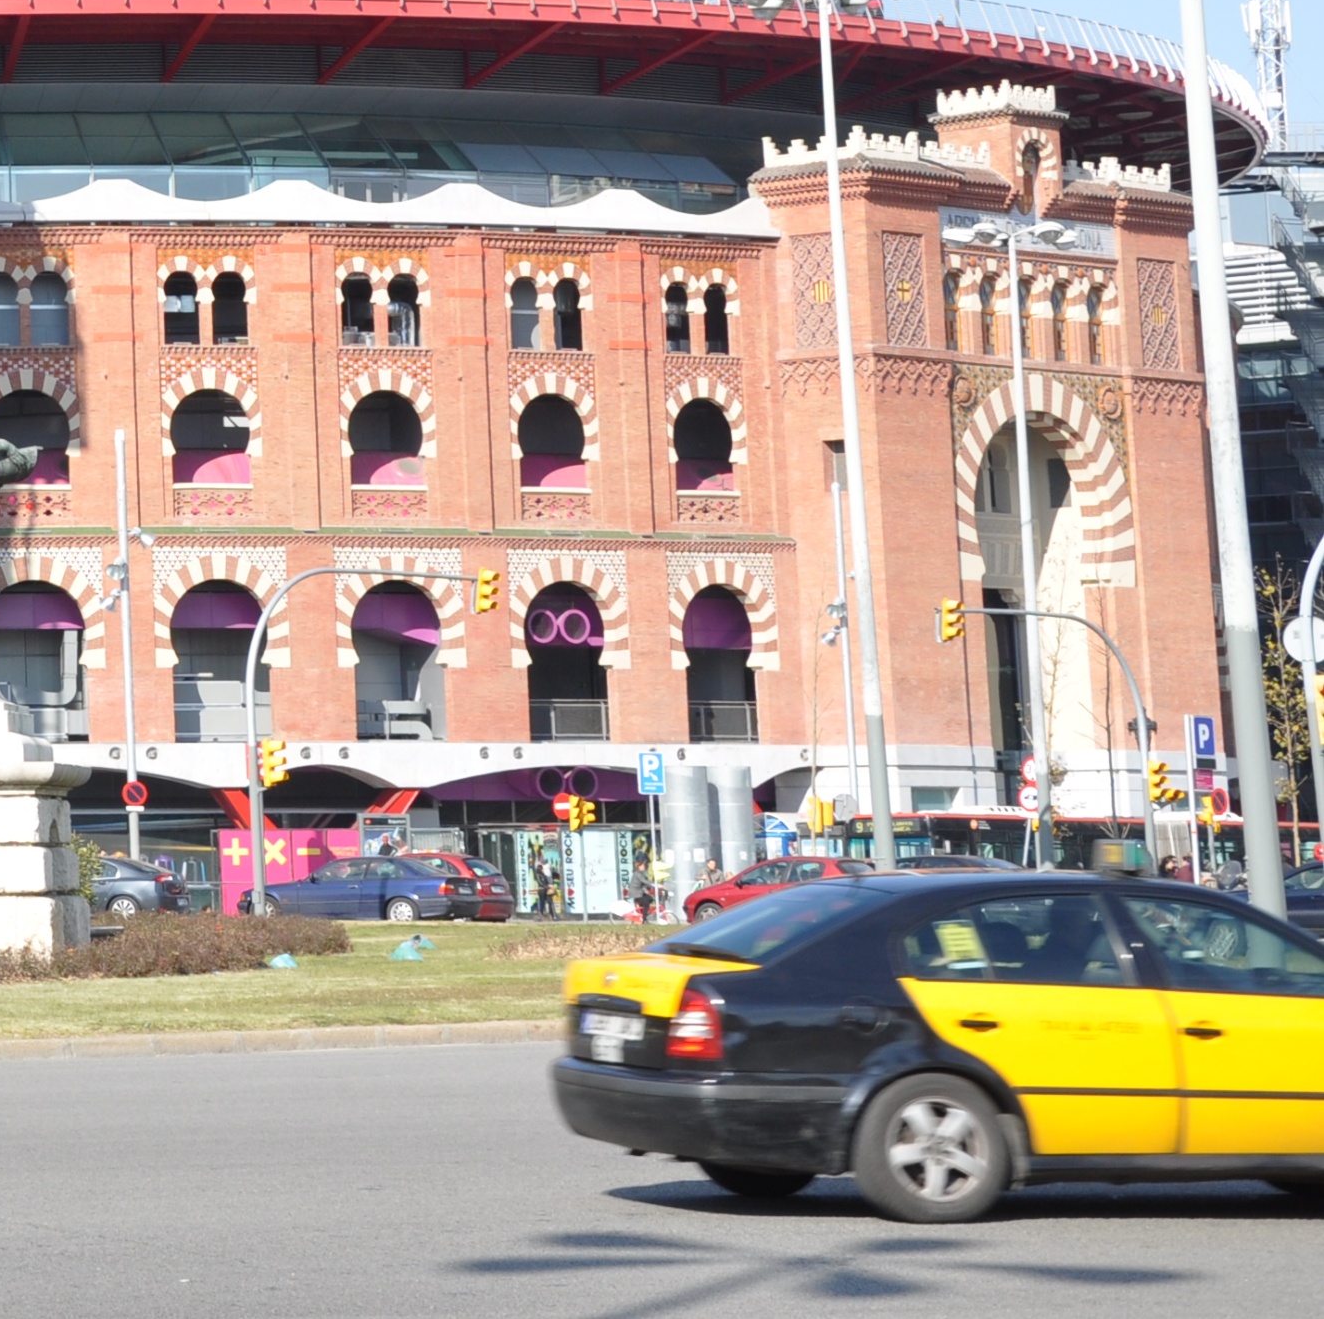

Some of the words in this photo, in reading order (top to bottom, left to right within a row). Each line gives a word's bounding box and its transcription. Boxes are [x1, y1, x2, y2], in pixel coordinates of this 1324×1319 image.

[1198, 723, 1210, 749] P
[642, 754, 659, 778] P
[855, 821, 864, 833] 9
[563, 831, 573, 864] ROCK
[619, 831, 629, 864] ROCK
